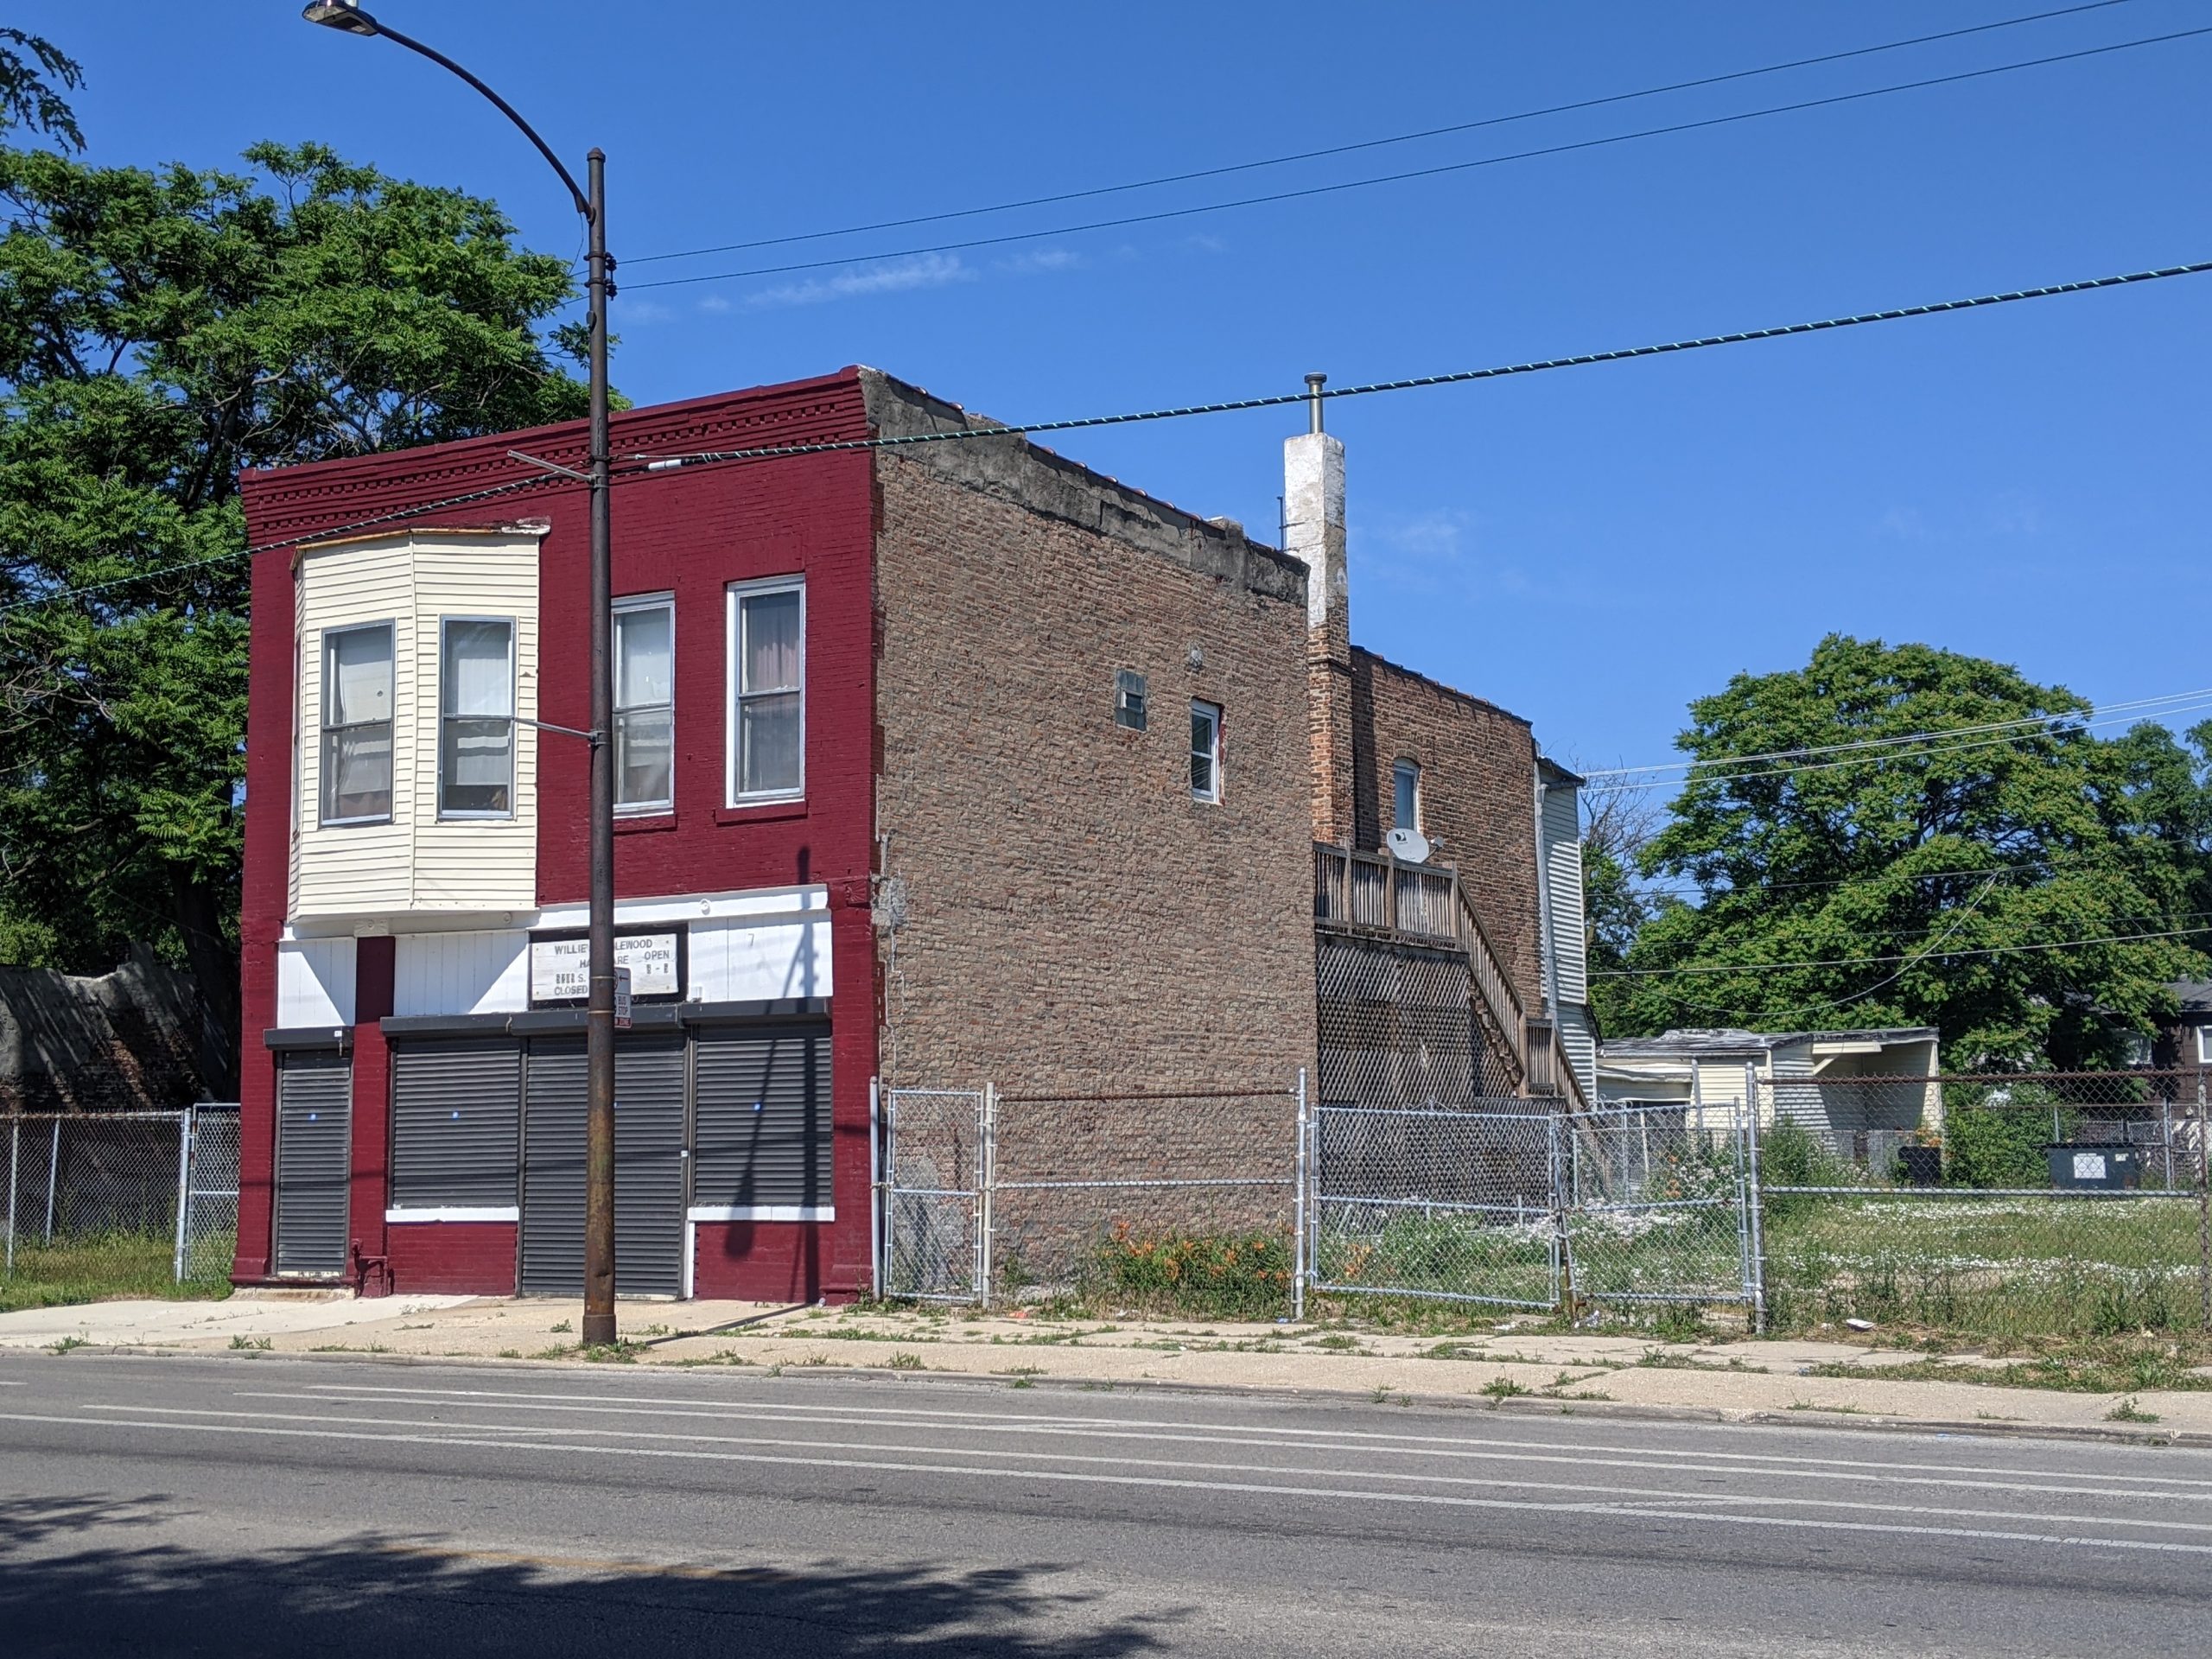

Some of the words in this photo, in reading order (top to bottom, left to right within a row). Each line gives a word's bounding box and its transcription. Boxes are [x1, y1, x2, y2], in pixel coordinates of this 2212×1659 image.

[614, 939, 652, 950] LEWOOD
[645, 950, 670, 960] OPEN
[554, 985, 588, 995] CLOSED
[618, 1006, 628, 1015] STOP
